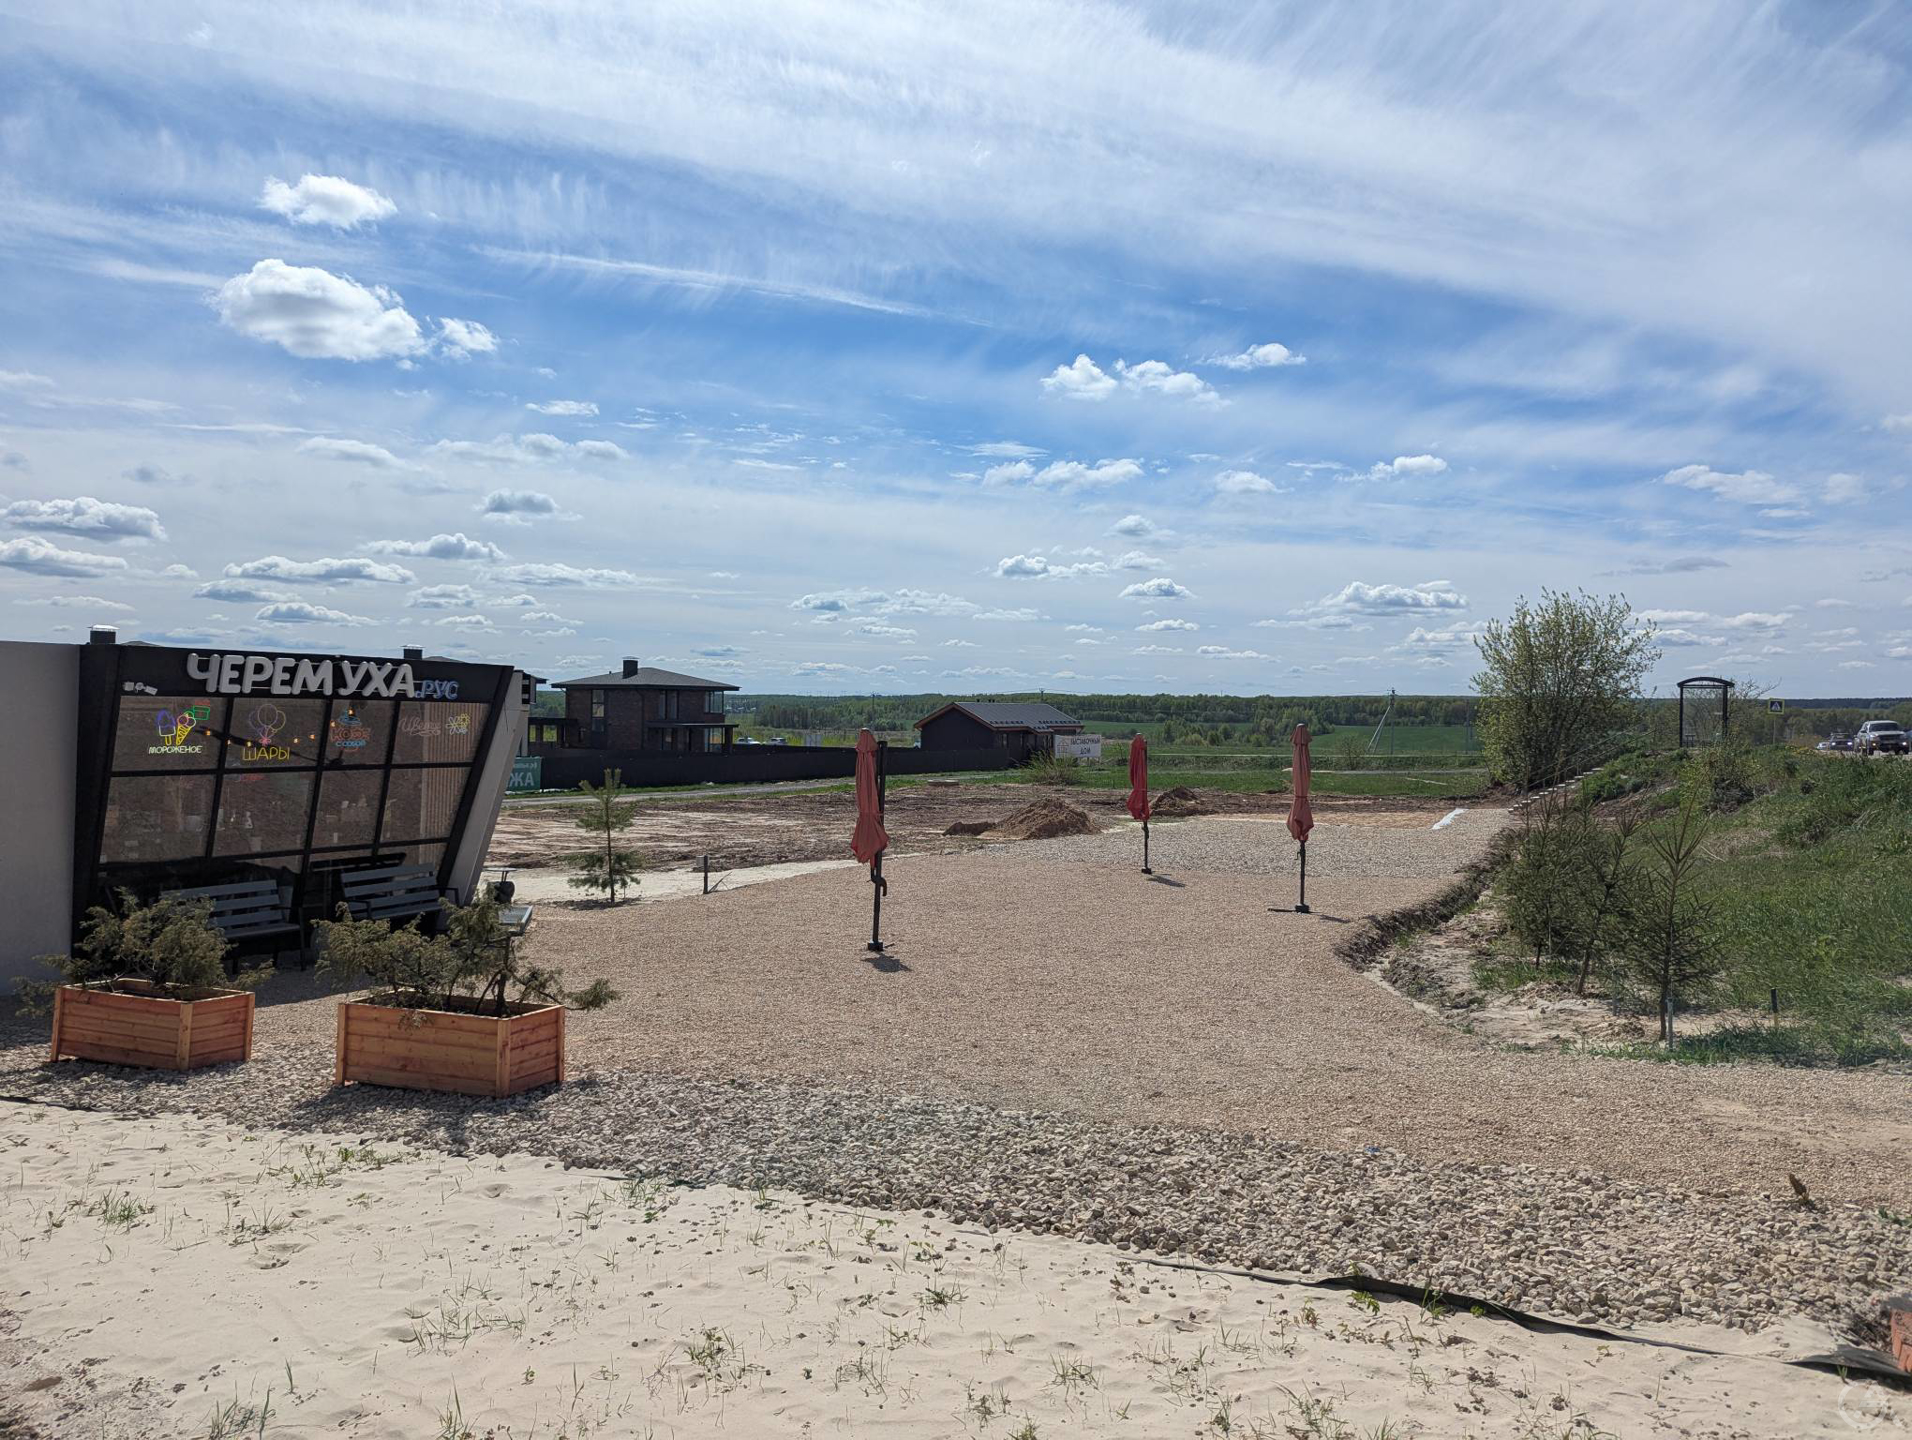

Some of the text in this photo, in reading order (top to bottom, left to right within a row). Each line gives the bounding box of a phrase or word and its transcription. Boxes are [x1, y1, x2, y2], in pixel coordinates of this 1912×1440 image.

[330, 728, 372, 741] КОФЕ
[148, 745, 202, 755] МОРОЖЕНОЕ
[242, 747, 290, 761] ШАРЫ
[507, 772, 535, 787] ЖА
